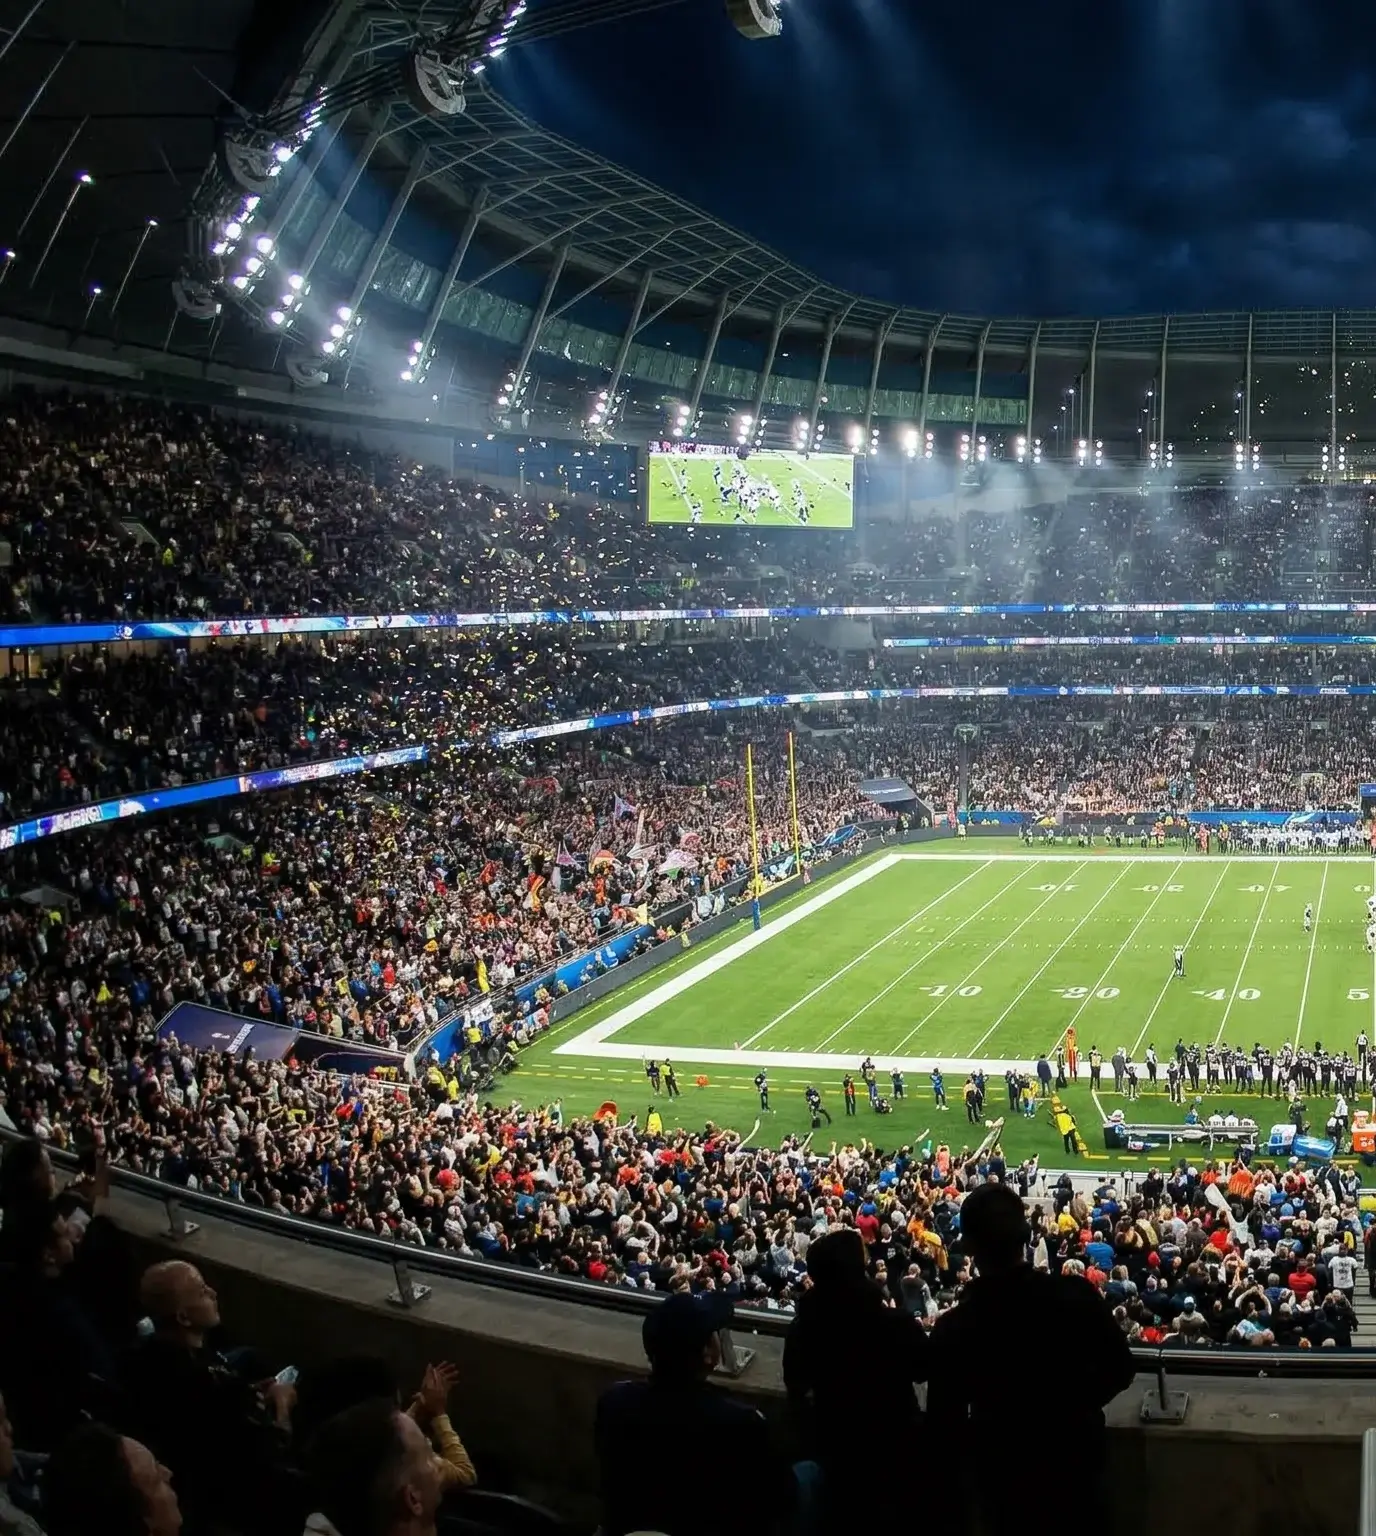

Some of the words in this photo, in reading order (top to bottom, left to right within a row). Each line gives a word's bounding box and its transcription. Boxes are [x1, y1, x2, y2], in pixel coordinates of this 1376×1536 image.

[928, 985, 983, 997] 10
[1061, 986, 1120, 999] 20
[1204, 988, 1261, 1000] 40
